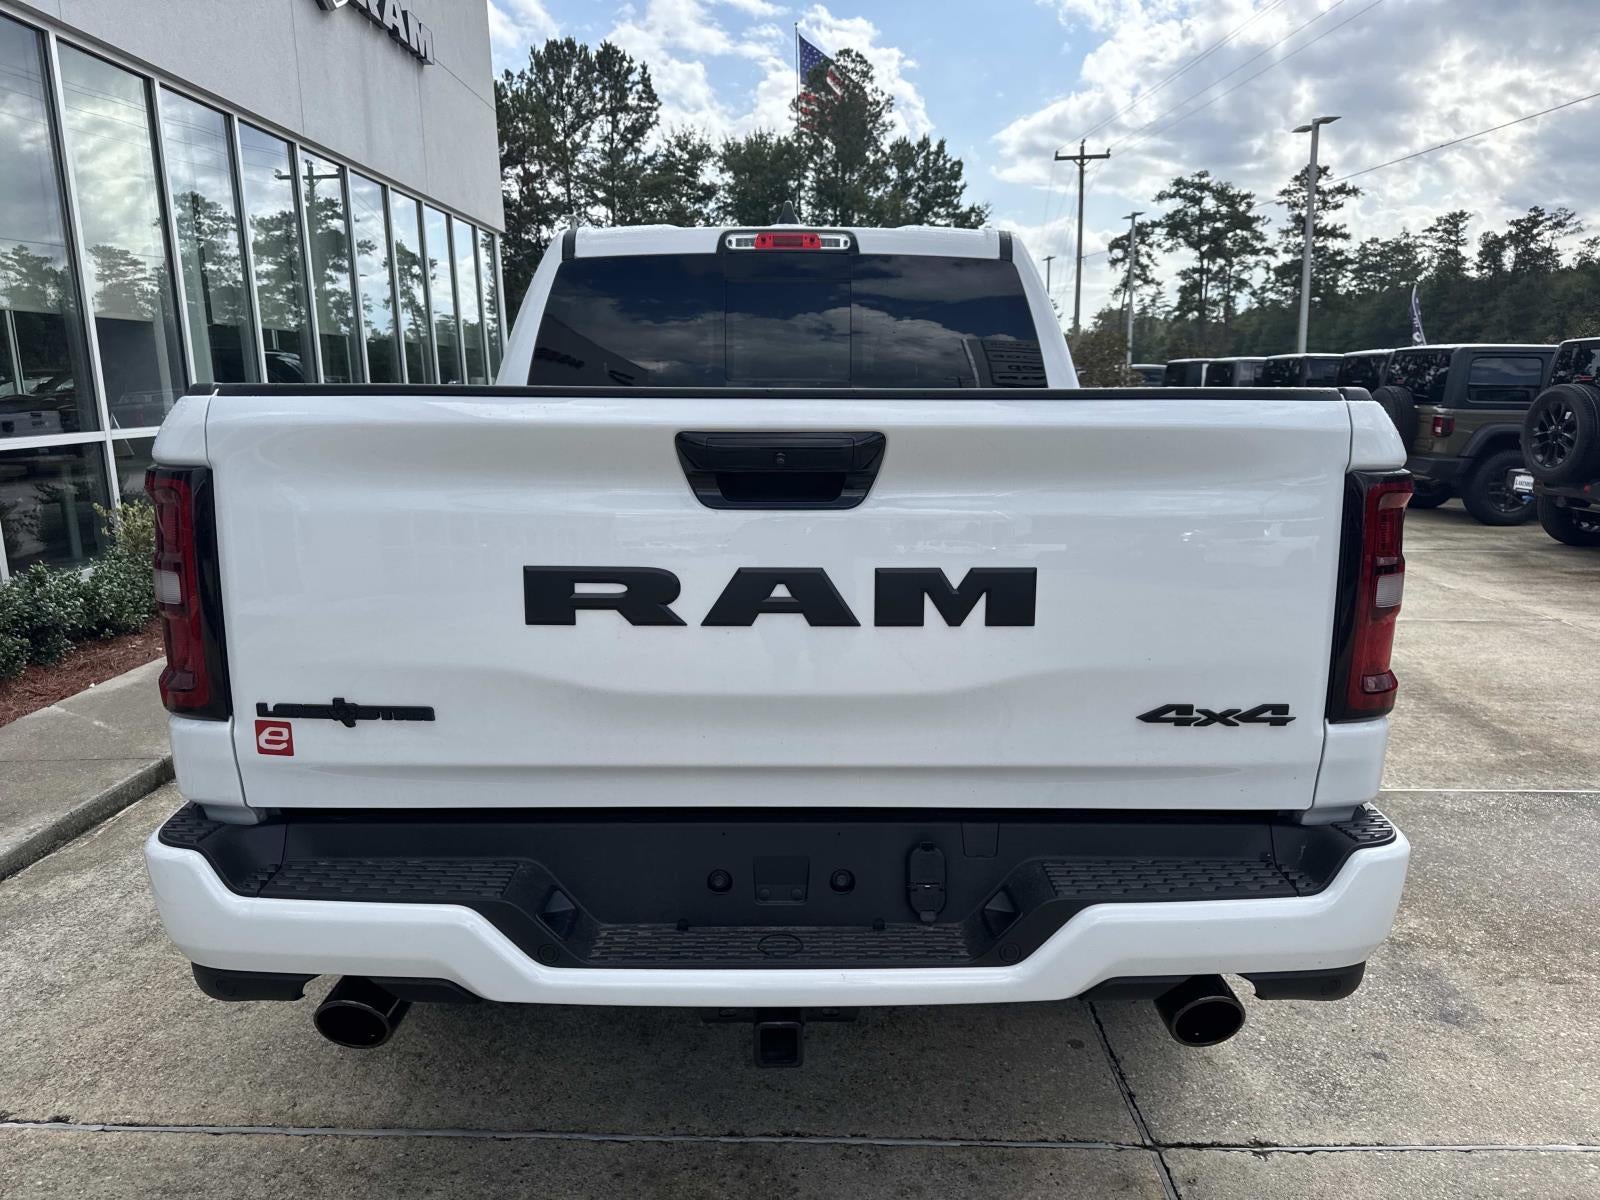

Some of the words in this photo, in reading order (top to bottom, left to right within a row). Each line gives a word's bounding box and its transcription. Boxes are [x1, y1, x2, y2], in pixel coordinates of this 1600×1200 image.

[523, 565, 1037, 627] RAM
[1136, 703, 1296, 726] 4x4
[258, 726, 290, 751] e
